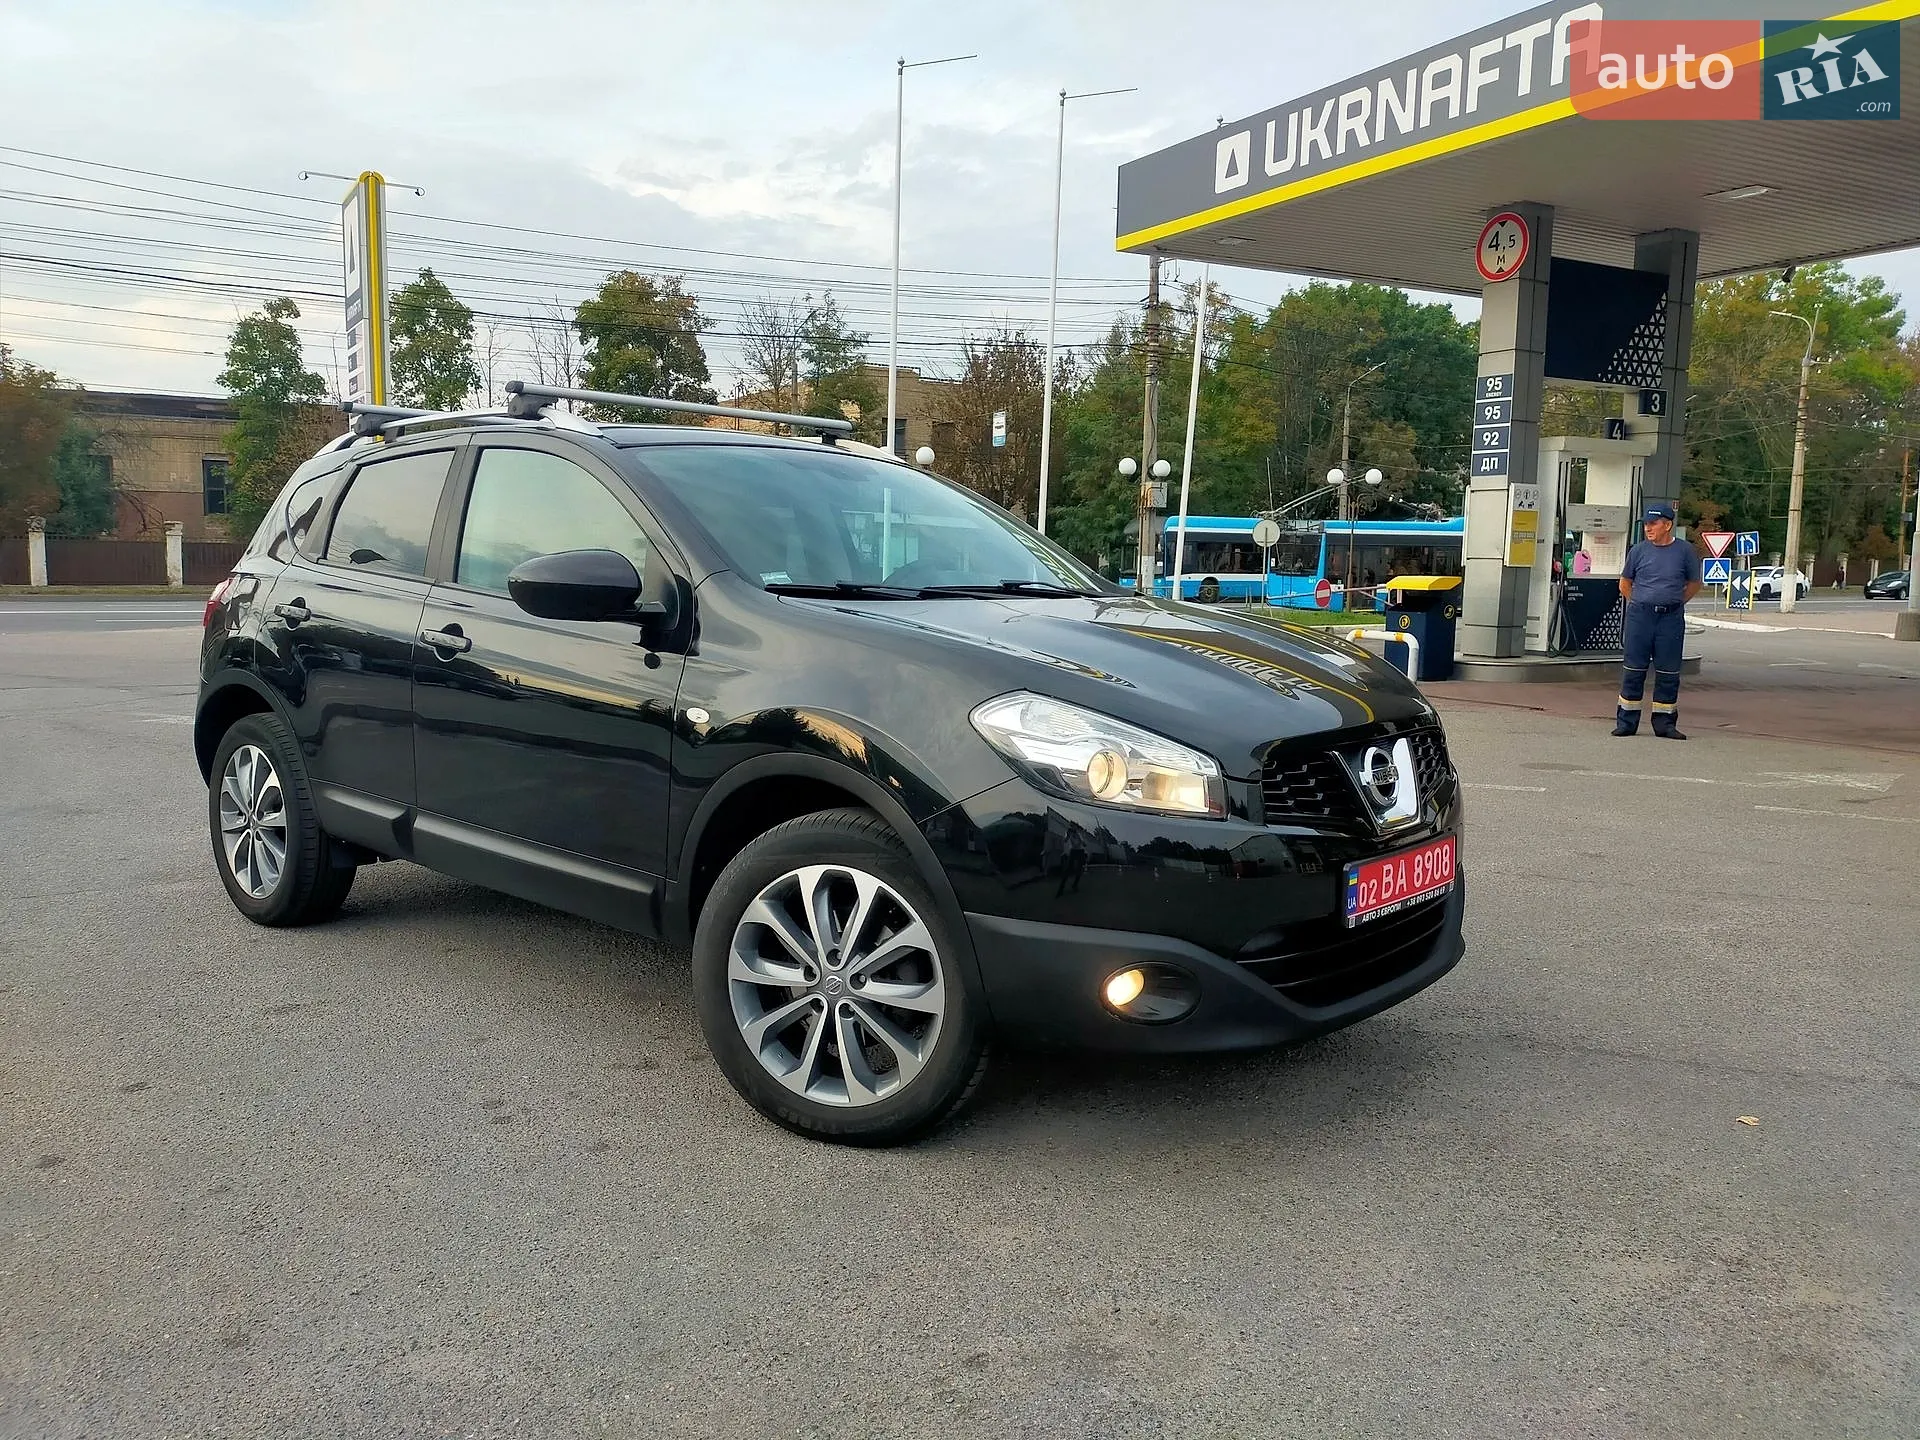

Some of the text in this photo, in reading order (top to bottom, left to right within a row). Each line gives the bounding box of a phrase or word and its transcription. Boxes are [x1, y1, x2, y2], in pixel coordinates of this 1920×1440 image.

[1264, 2, 1604, 177] UKRNAFTA
[1488, 230, 1516, 252] 4,5
[1486, 377, 1503, 392] 95
[1651, 393, 1660, 413] 3
[1484, 405, 1501, 420] 95
[1482, 431, 1500, 446] 92
[1612, 422, 1622, 440] 4
[1480, 457, 1499, 472] ДП
[1359, 879, 1378, 908] 02
[1413, 844, 1450, 888] 8908
[1347, 896, 1357, 909] UA
